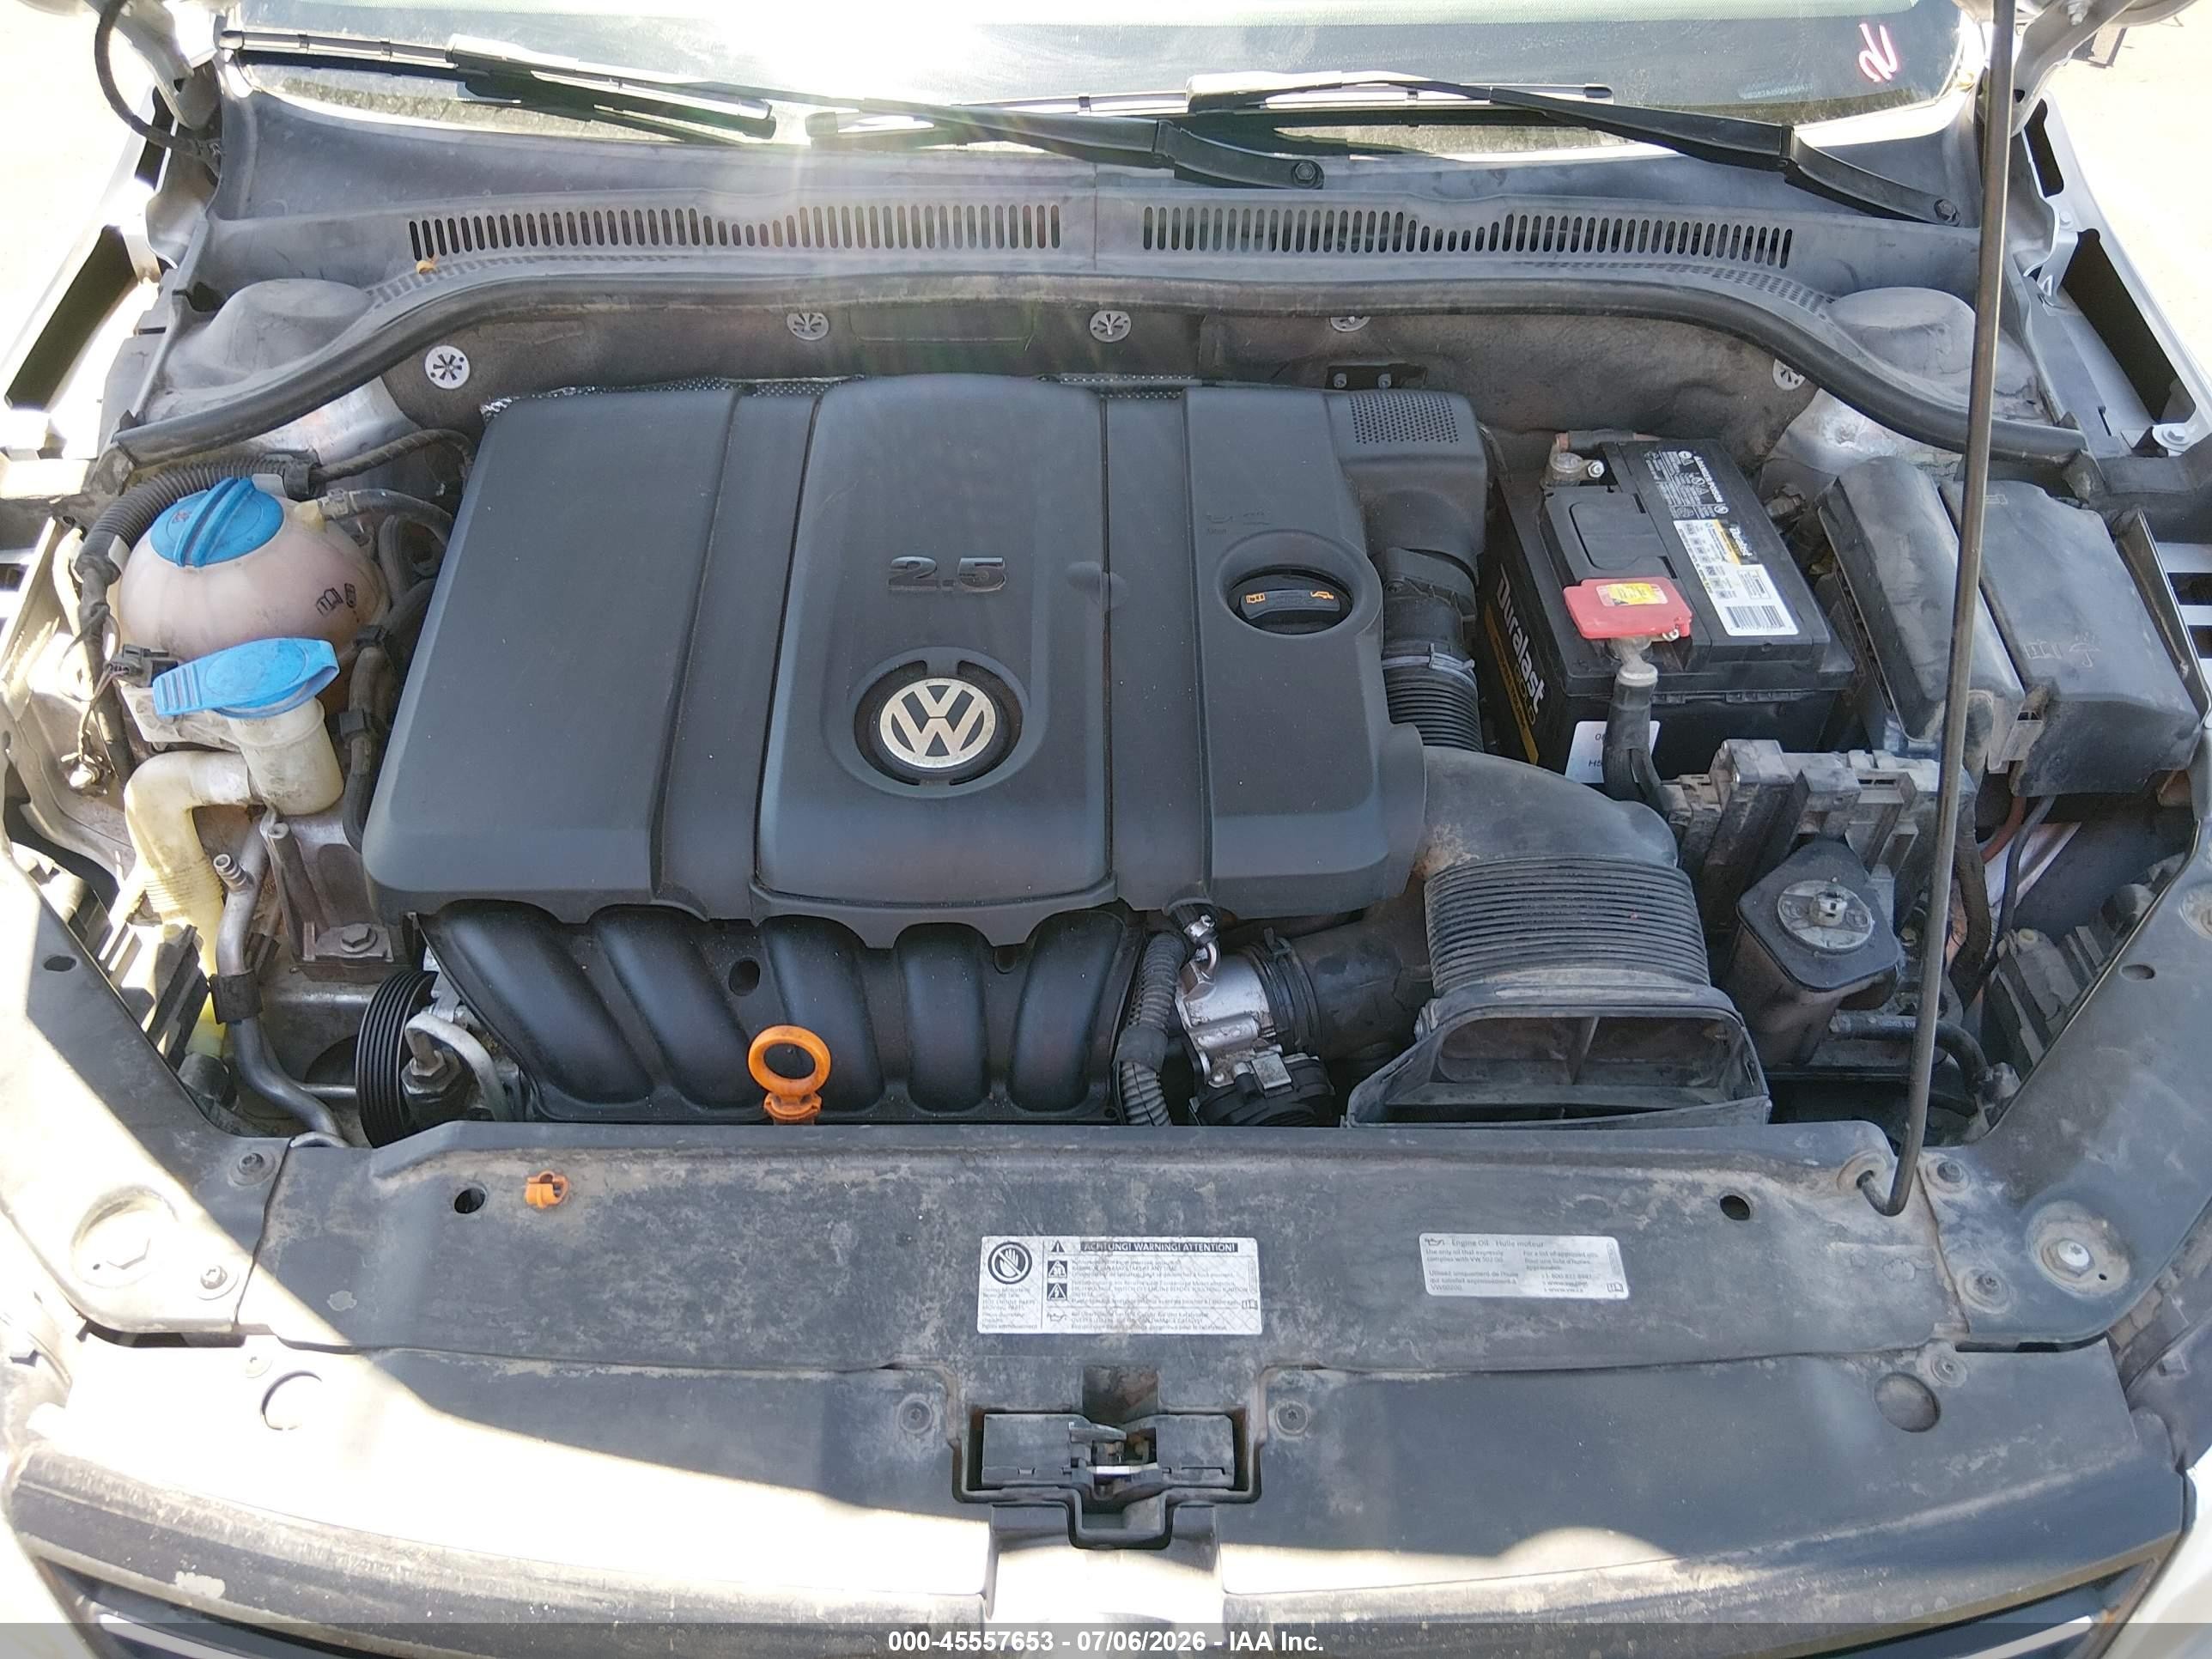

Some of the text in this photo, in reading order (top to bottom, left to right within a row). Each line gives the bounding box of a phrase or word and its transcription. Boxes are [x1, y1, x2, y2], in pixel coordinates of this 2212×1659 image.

[887, 556, 1006, 592] 2.5
[1497, 563, 1545, 715] Duralast
[1133, 1242, 1182, 1252] WARNING!
[1182, 1243, 1236, 1252] ATTENTION!
